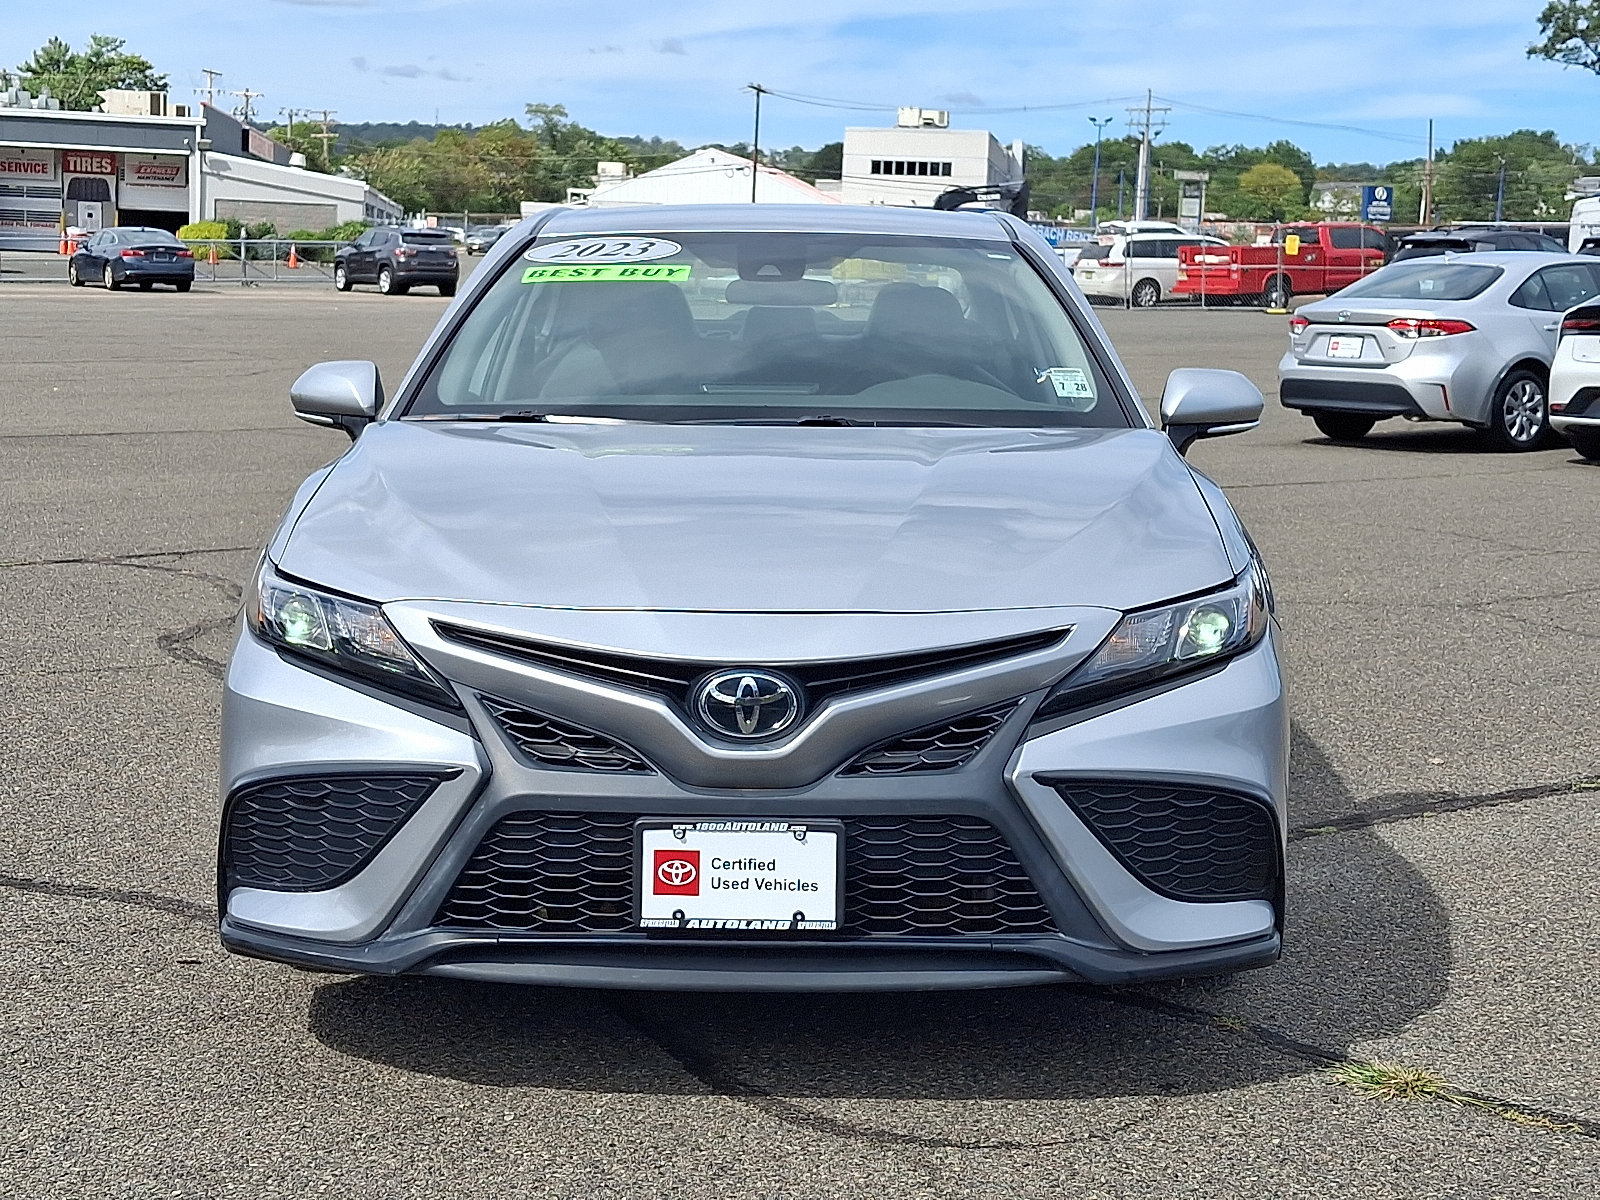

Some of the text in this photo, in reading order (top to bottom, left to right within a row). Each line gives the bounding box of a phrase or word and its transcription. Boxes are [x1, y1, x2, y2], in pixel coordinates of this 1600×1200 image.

[0, 161, 49, 174] SERVICE
[67, 156, 112, 173] TIRES
[140, 165, 178, 175] EXPRESS
[137, 174, 176, 182] MAINTENANCE
[549, 241, 657, 259] 2023
[528, 267, 686, 279] BEST BUY
[1058, 382, 1088, 392] 7 28
[711, 857, 776, 872] Certified
[711, 876, 819, 893] Used Vehicles
[685, 919, 792, 931] AUTOLAND
